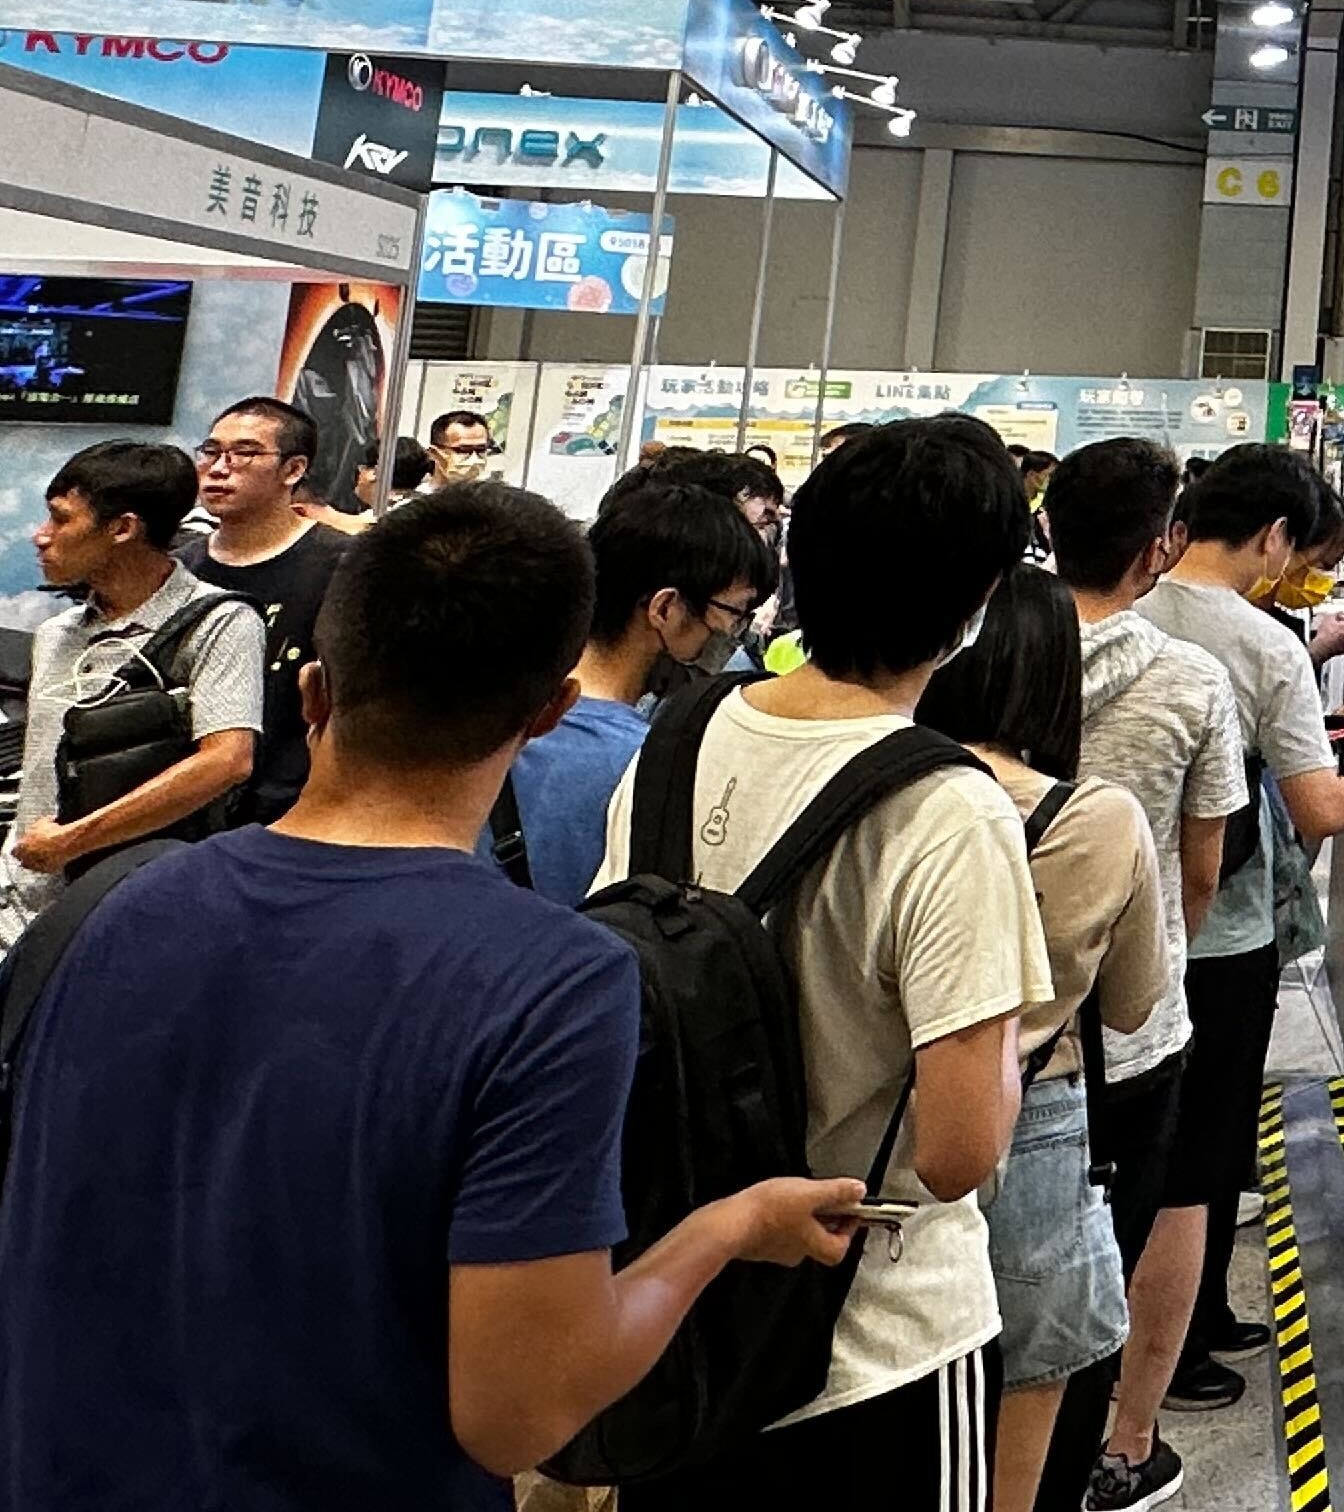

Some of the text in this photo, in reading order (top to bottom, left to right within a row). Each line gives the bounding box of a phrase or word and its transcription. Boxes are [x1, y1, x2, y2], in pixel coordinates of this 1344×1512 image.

[373, 67, 424, 112] KYMCO
[424, 223, 588, 283] 活動區
